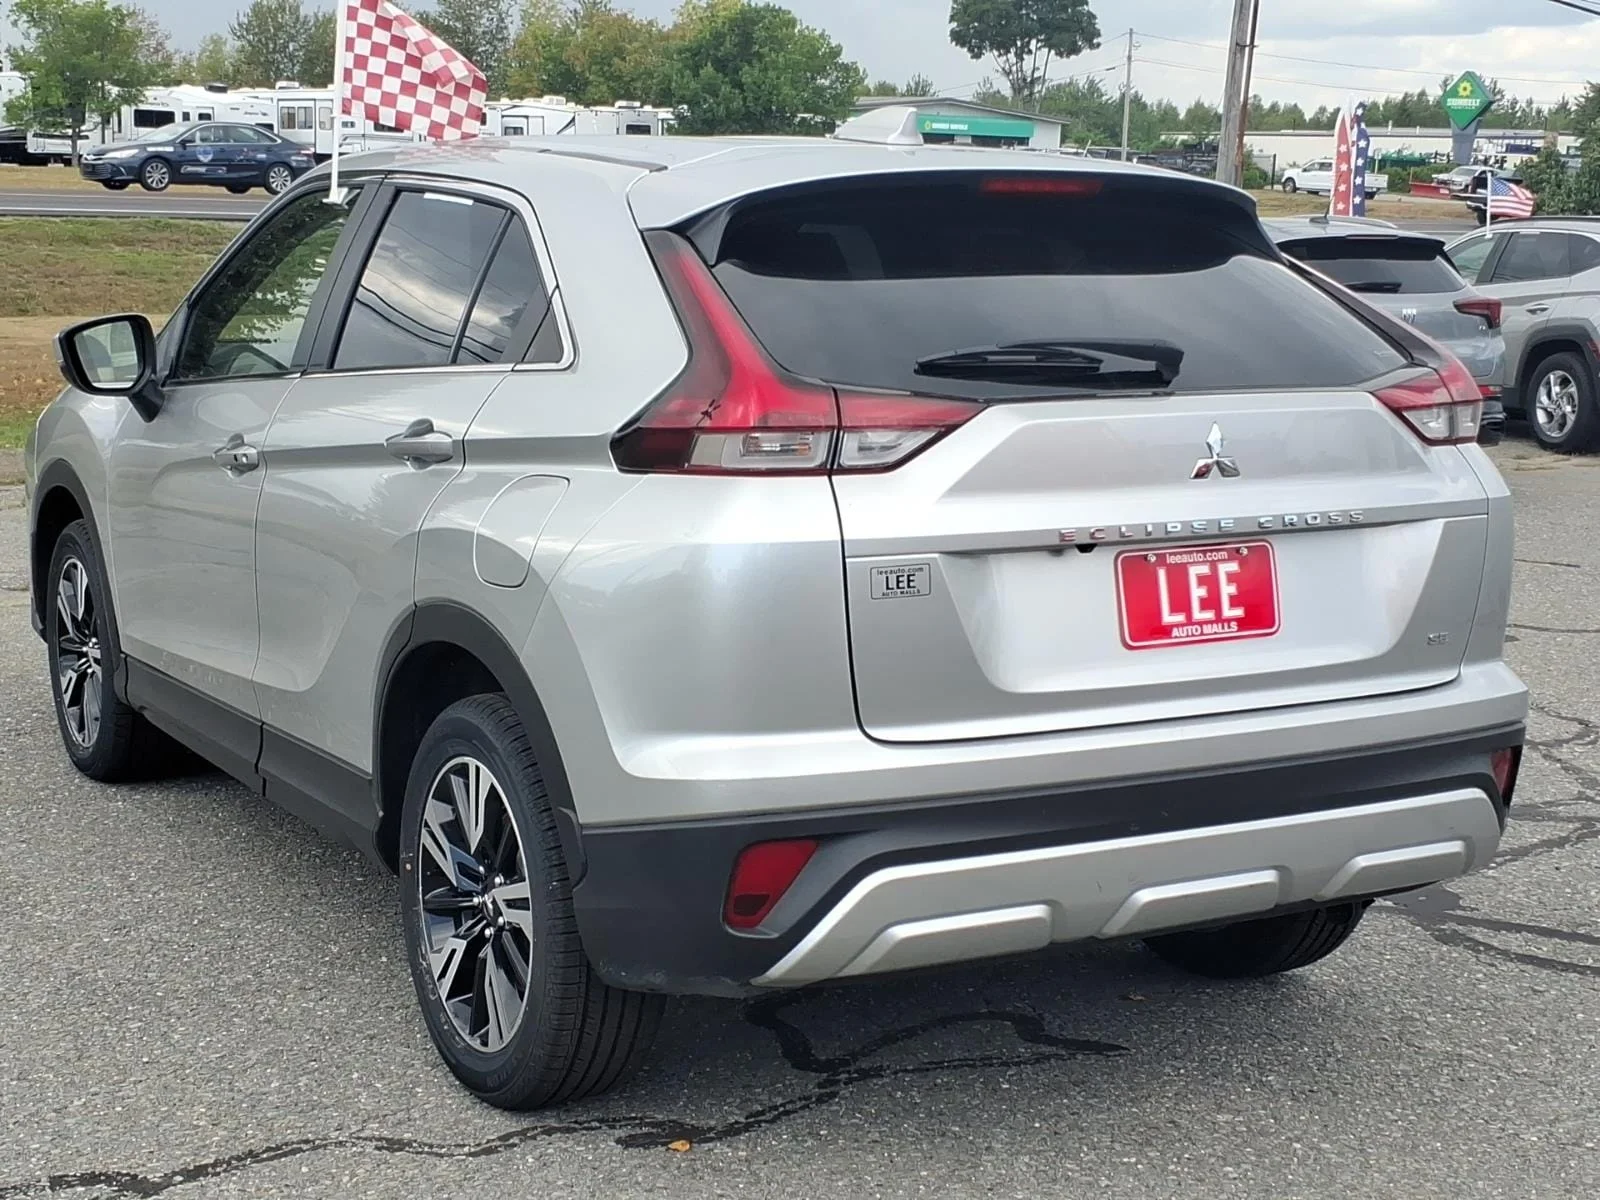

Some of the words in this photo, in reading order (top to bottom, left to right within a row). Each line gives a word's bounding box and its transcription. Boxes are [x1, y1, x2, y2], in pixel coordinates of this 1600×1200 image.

[1059, 518, 1236, 542] ECLIPSE
[1257, 510, 1365, 530] CROSS
[1166, 550, 1228, 564] leeauto.com
[876, 567, 924, 576] leeauto.com
[885, 573, 917, 591] LEE
[1156, 560, 1246, 626] LEE
[1171, 625, 1201, 638] AUTO
[1203, 622, 1239, 635] MALLS
